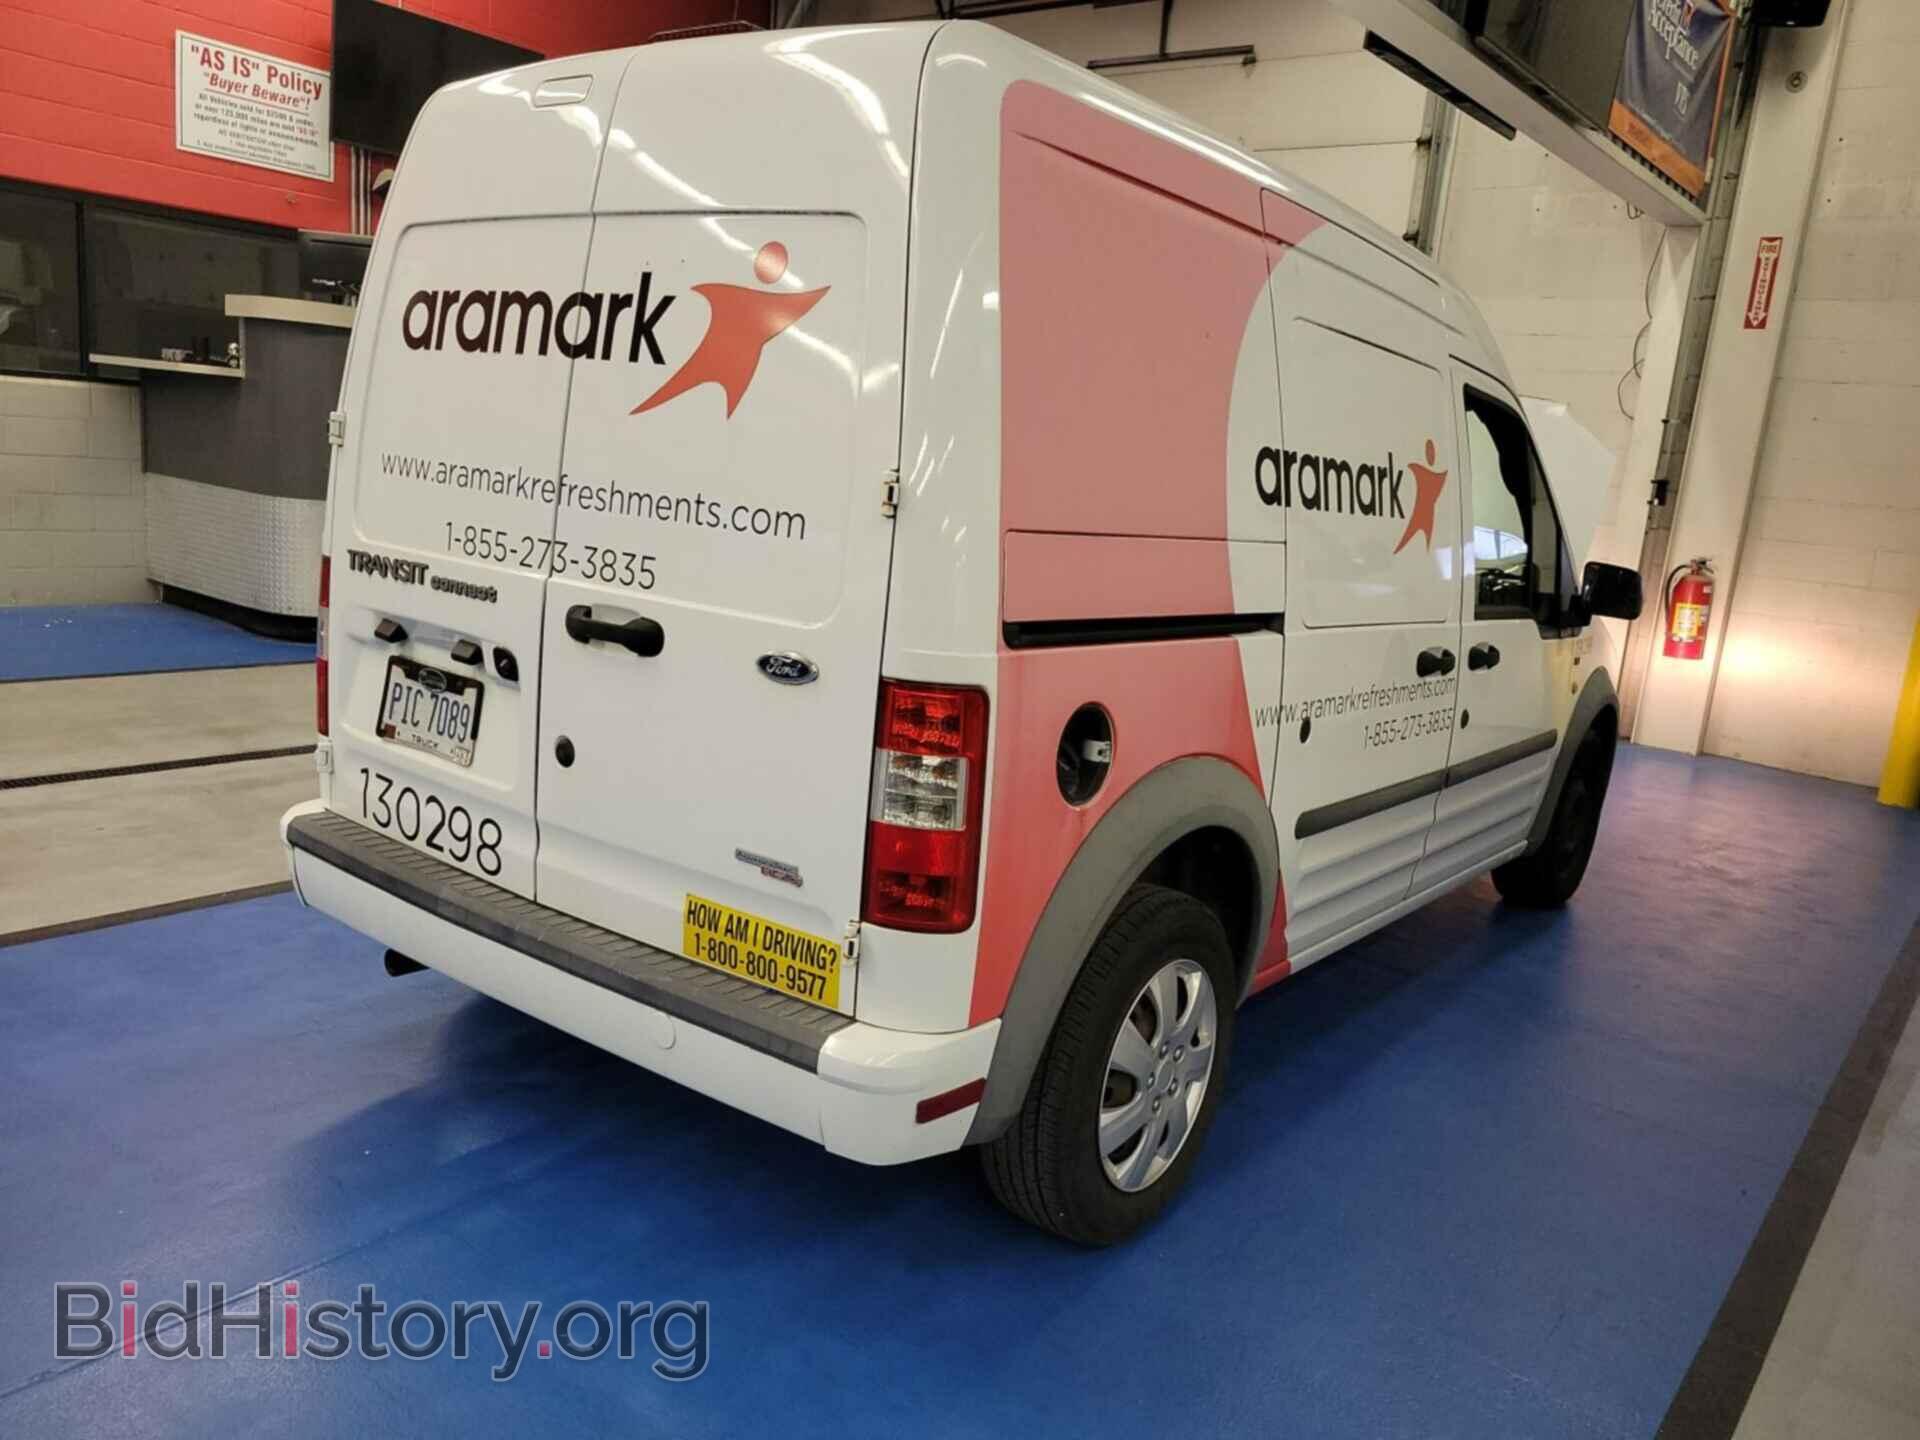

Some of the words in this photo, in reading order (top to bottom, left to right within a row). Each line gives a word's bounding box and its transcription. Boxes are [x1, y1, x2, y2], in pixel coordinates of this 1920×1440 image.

[191, 44, 225, 71] "AS
[232, 55, 260, 78] IS"
[267, 65, 323, 100] Policy
[1760, 244, 1778, 254] FIRE
[402, 271, 676, 365] aramark
[381, 451, 806, 541] www.aramarkrefreshments.com
[1255, 446, 1405, 519] aramark
[347, 549, 429, 585] TRANSIT
[446, 521, 656, 590] 1-855-273-3835
[388, 682, 424, 727] PIC
[427, 692, 470, 743] 7089
[1255, 677, 1456, 728] www.aramarkrefreshments.com
[1363, 707, 1453, 749] 1-855-273-3835
[360, 767, 502, 877] 130298
[687, 900, 722, 933] HOW
[724, 913, 750, 945] AM
[752, 922, 760, 947] I
[762, 926, 837, 974] DRIVING?
[694, 933, 827, 1000] 1-800-800-9577
